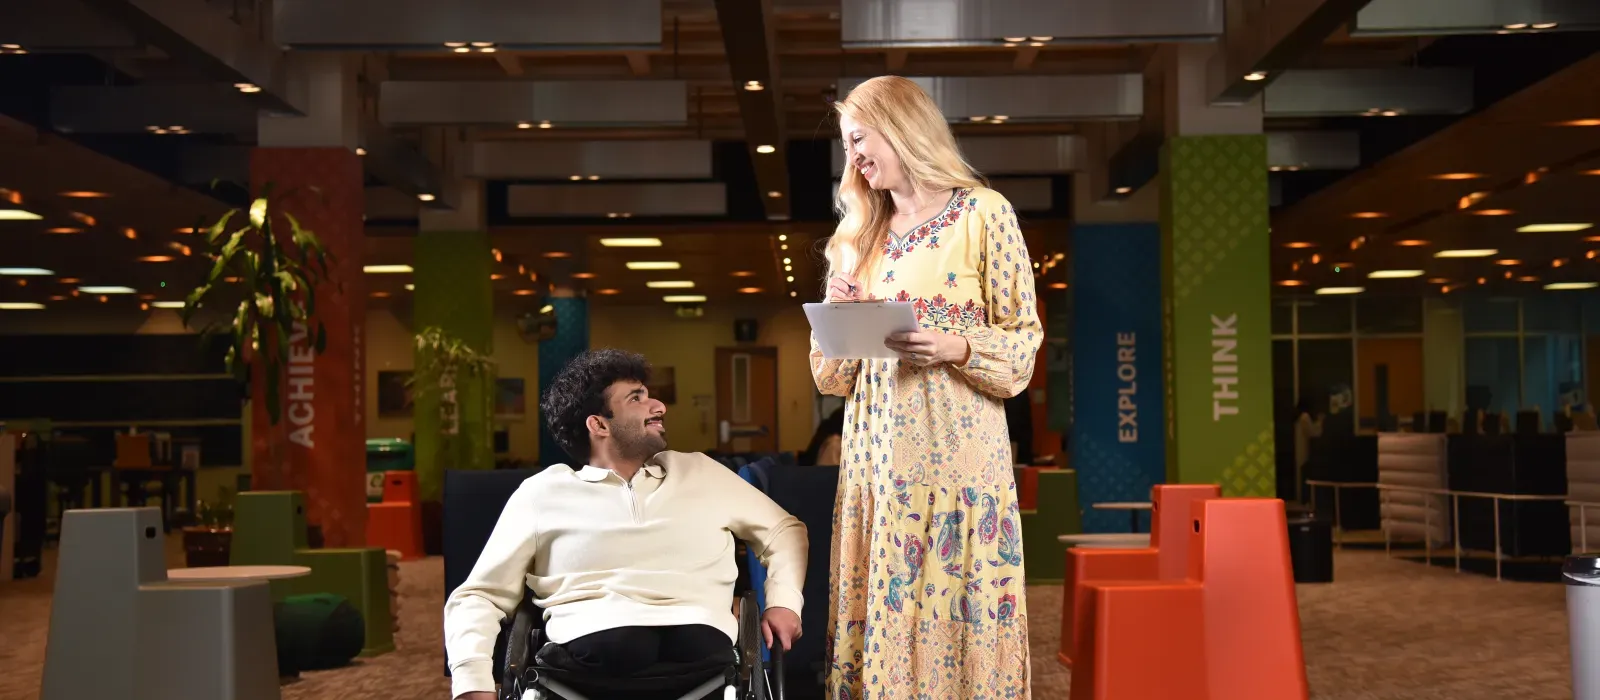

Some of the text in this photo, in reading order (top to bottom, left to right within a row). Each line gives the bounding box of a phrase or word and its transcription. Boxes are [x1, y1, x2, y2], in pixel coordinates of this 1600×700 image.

[288, 299, 315, 449] ACHIEV
[1116, 332, 1138, 443] EXPLORE
[1210, 312, 1239, 421] THINK
